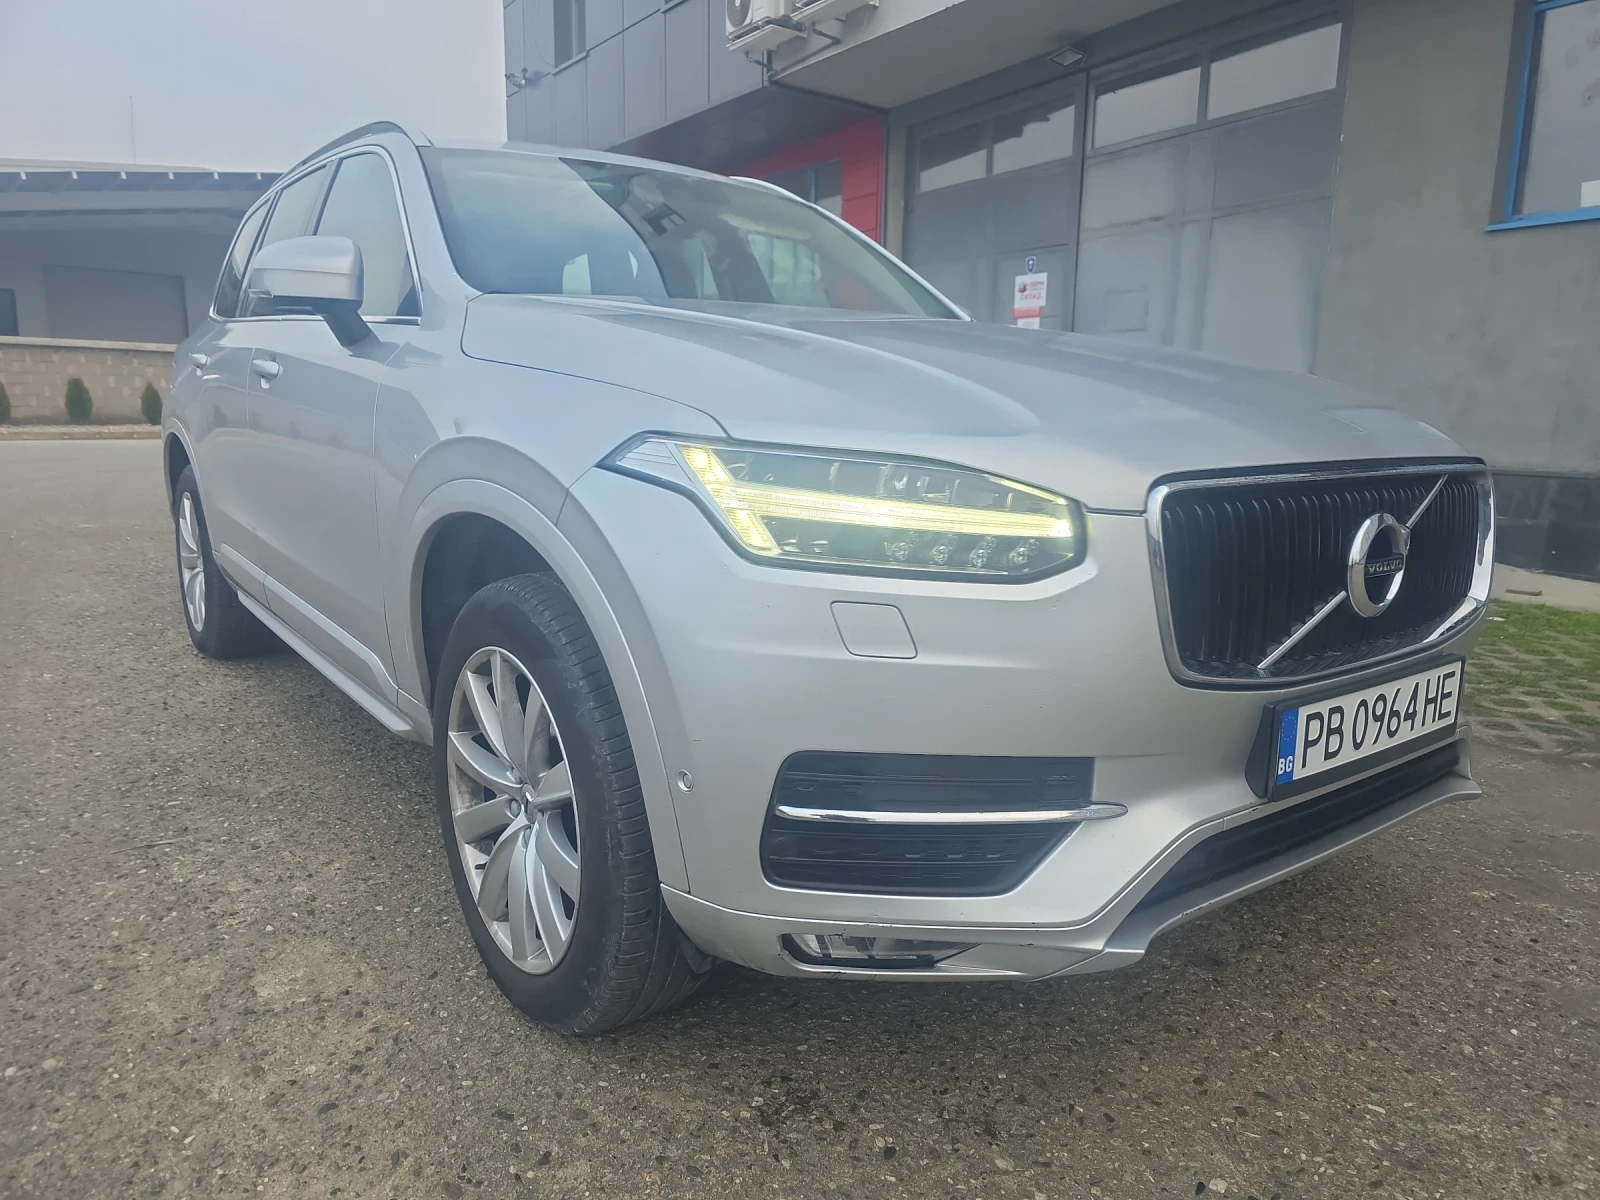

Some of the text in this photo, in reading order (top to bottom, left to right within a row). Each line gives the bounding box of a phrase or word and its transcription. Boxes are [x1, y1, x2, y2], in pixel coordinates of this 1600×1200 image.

[1367, 559, 1402, 574] VOLVO
[1300, 670, 1456, 769] PB 0964 HE
[1277, 755, 1293, 776] BG
